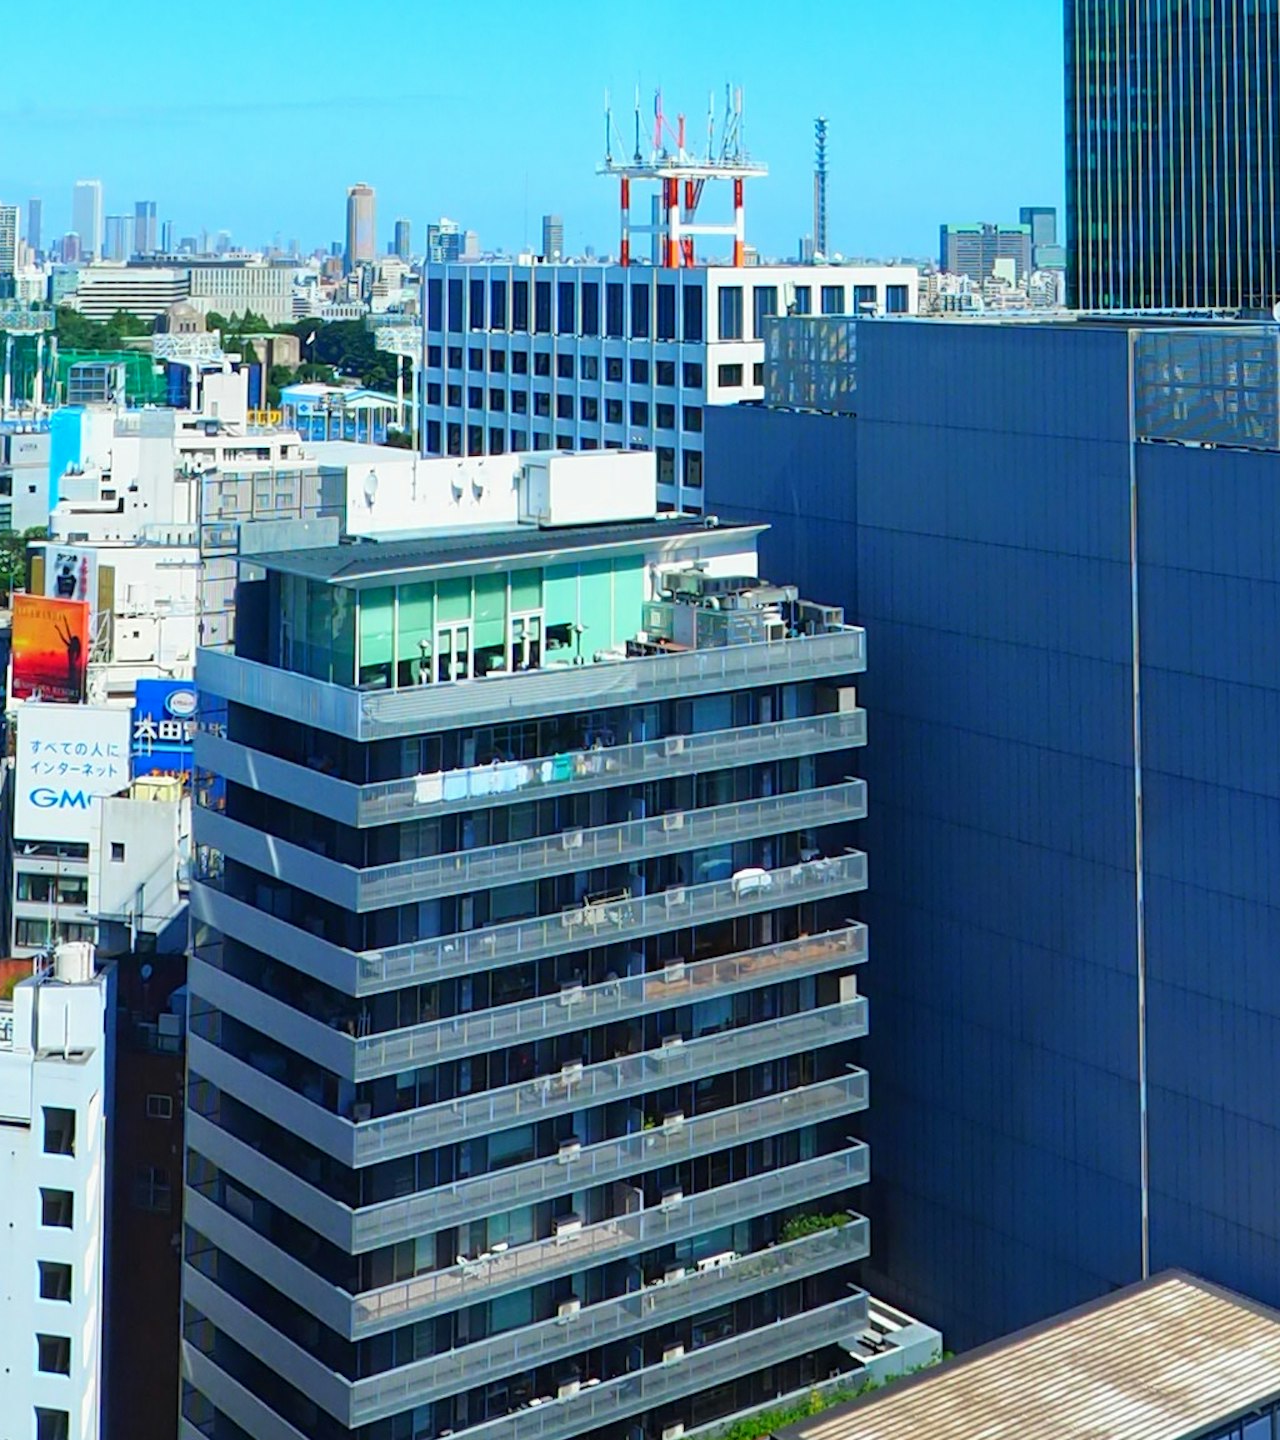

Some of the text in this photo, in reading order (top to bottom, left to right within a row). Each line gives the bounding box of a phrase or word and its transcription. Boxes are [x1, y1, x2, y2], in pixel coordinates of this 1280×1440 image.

[30, 739, 120, 757] すべての人に
[31, 761, 118, 777] インターネット
[29, 788, 91, 810] GM
